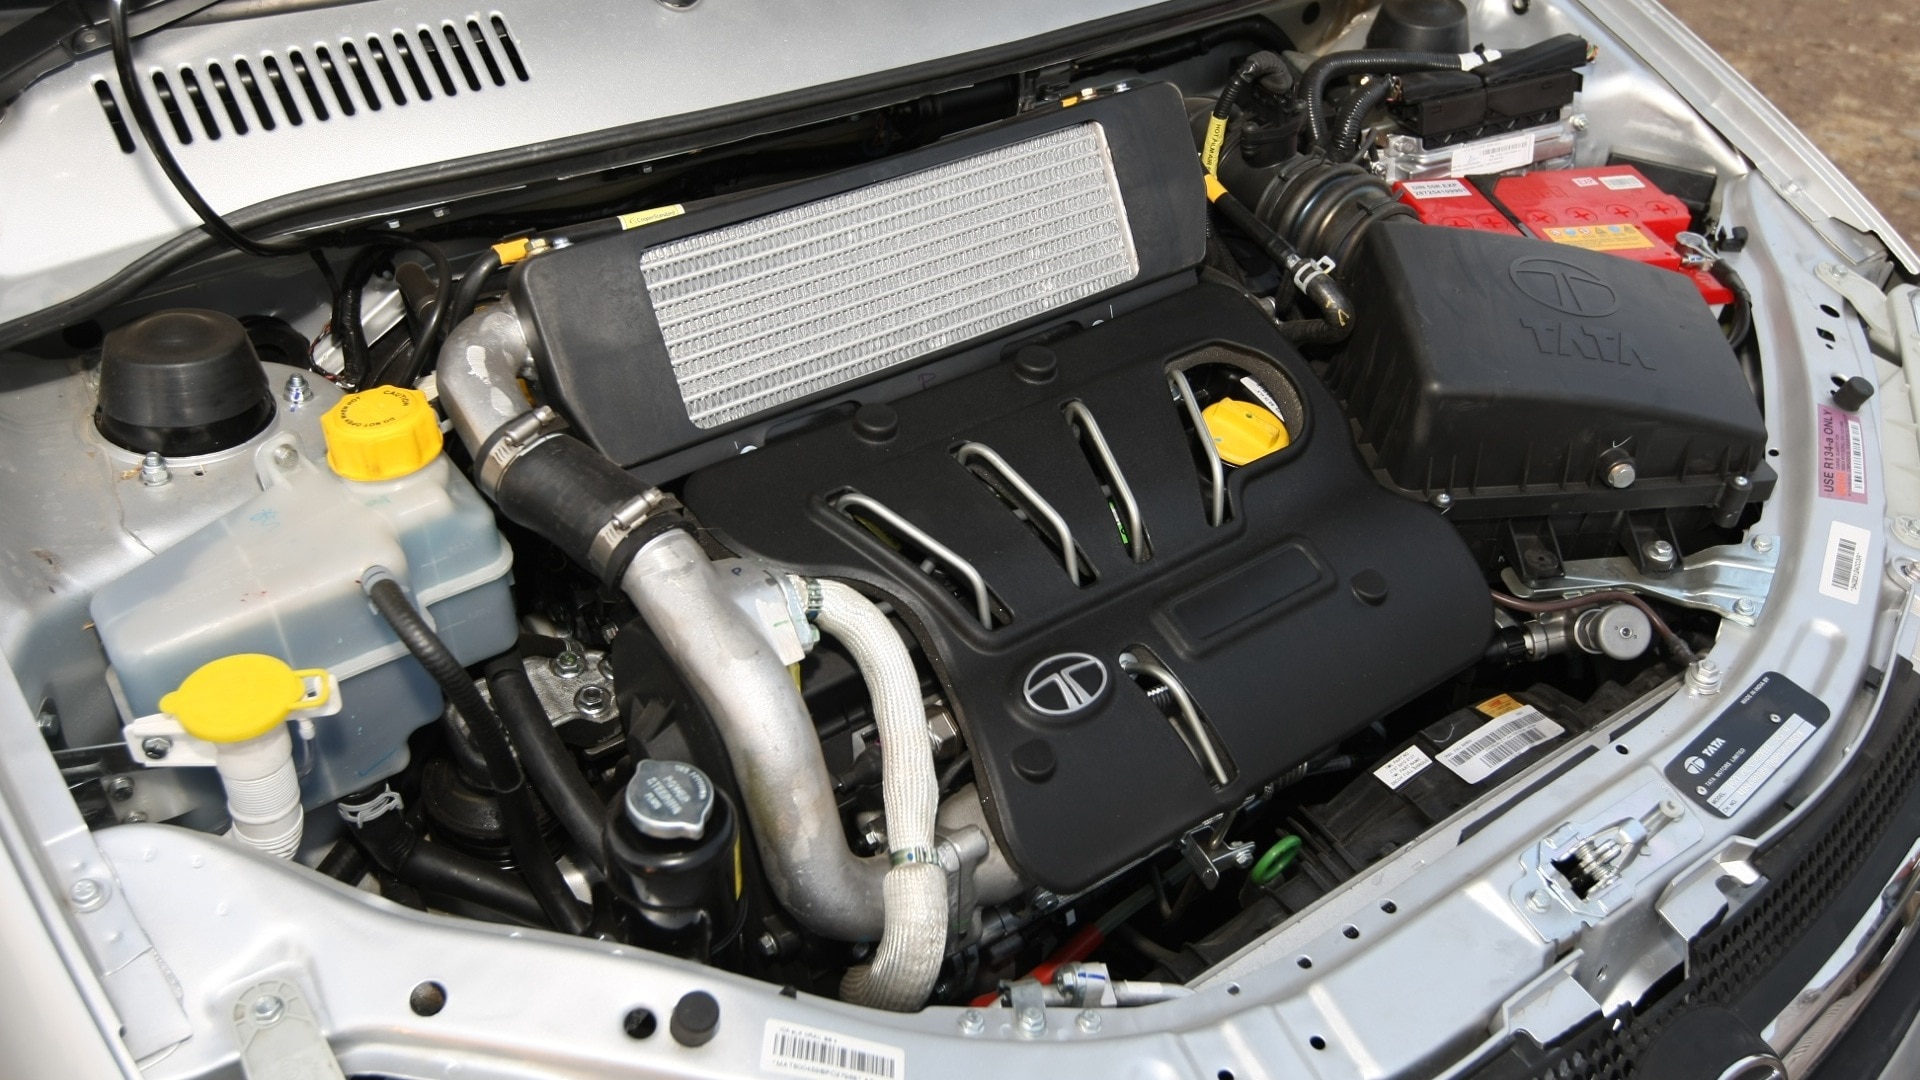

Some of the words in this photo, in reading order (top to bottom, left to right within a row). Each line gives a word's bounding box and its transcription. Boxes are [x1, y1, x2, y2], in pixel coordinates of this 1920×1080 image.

[1208, 138, 1217, 155] FILM
[1520, 318, 1656, 370] TATA
[347, 396, 361, 406] HOT
[383, 390, 410, 407] CAUTION
[345, 419, 362, 427] OPEN
[1823, 410, 1834, 435] ONLY
[1824, 438, 1834, 470] R134-a
[1824, 471, 1834, 493] USE
[1740, 694, 1752, 705] MADE
[1756, 681, 1765, 692] INDIA
[1702, 737, 1727, 756] TATA
[1705, 777, 1716, 787] TATA
[1715, 761, 1732, 779] MOTORS
[1731, 748, 1746, 763] LIMITED
[646, 777, 682, 815] STEERING
[663, 775, 691, 803] POWER
